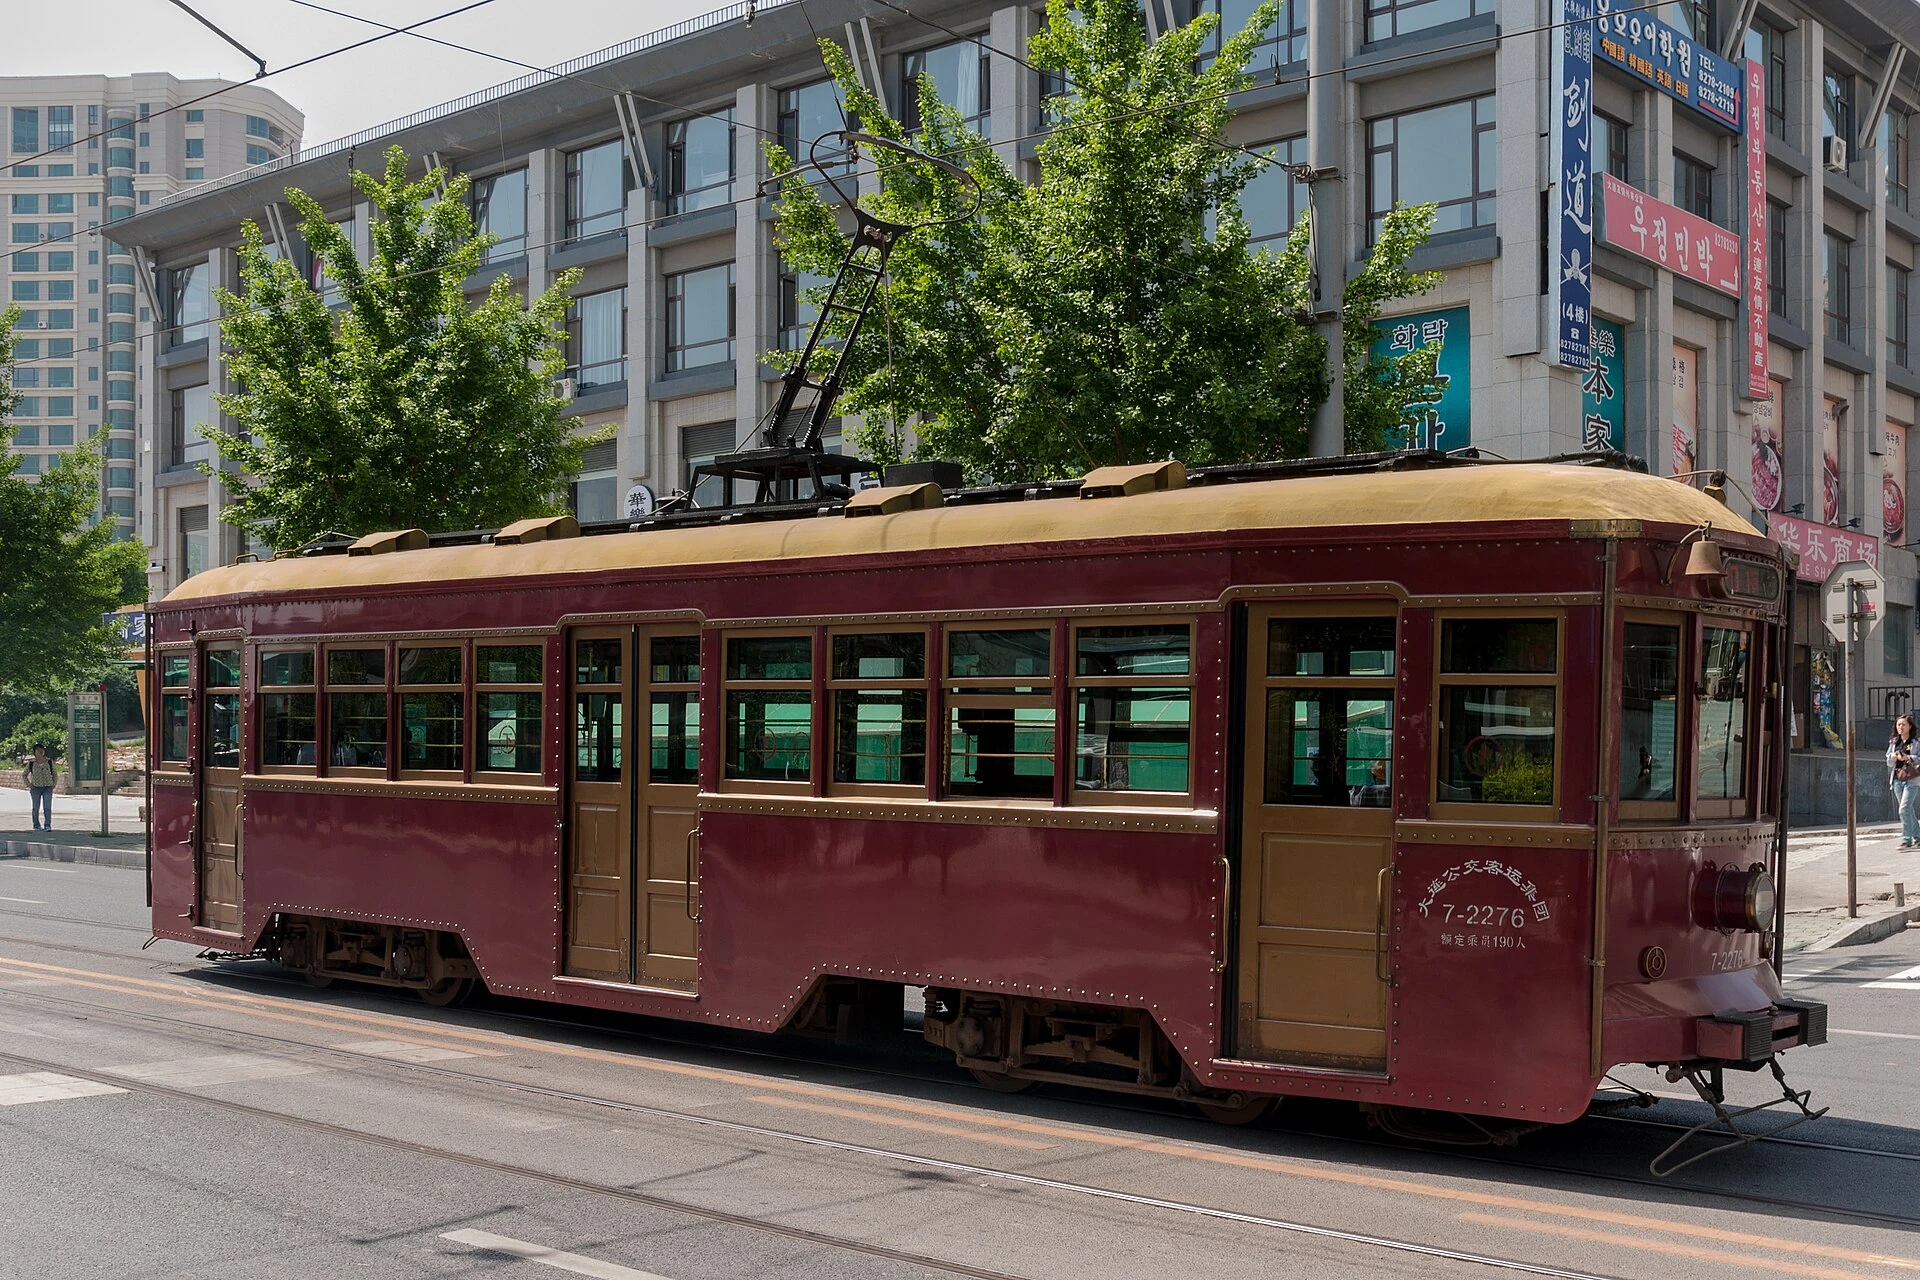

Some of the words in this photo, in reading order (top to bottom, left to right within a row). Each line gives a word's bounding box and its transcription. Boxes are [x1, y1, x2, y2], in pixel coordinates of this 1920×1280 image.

[1699, 54, 1715, 72] TEL:
[1698, 85, 1734, 115] 8278-2719
[1630, 205, 1713, 282] 우정민박
[1390, 319, 1448, 352] 화락
[1779, 521, 1877, 567] 华乐商场
[1418, 859, 1550, 922] 大连公交客运集团
[1443, 904, 1525, 928] 7-2276
[1711, 950, 1744, 971] 7-2276
